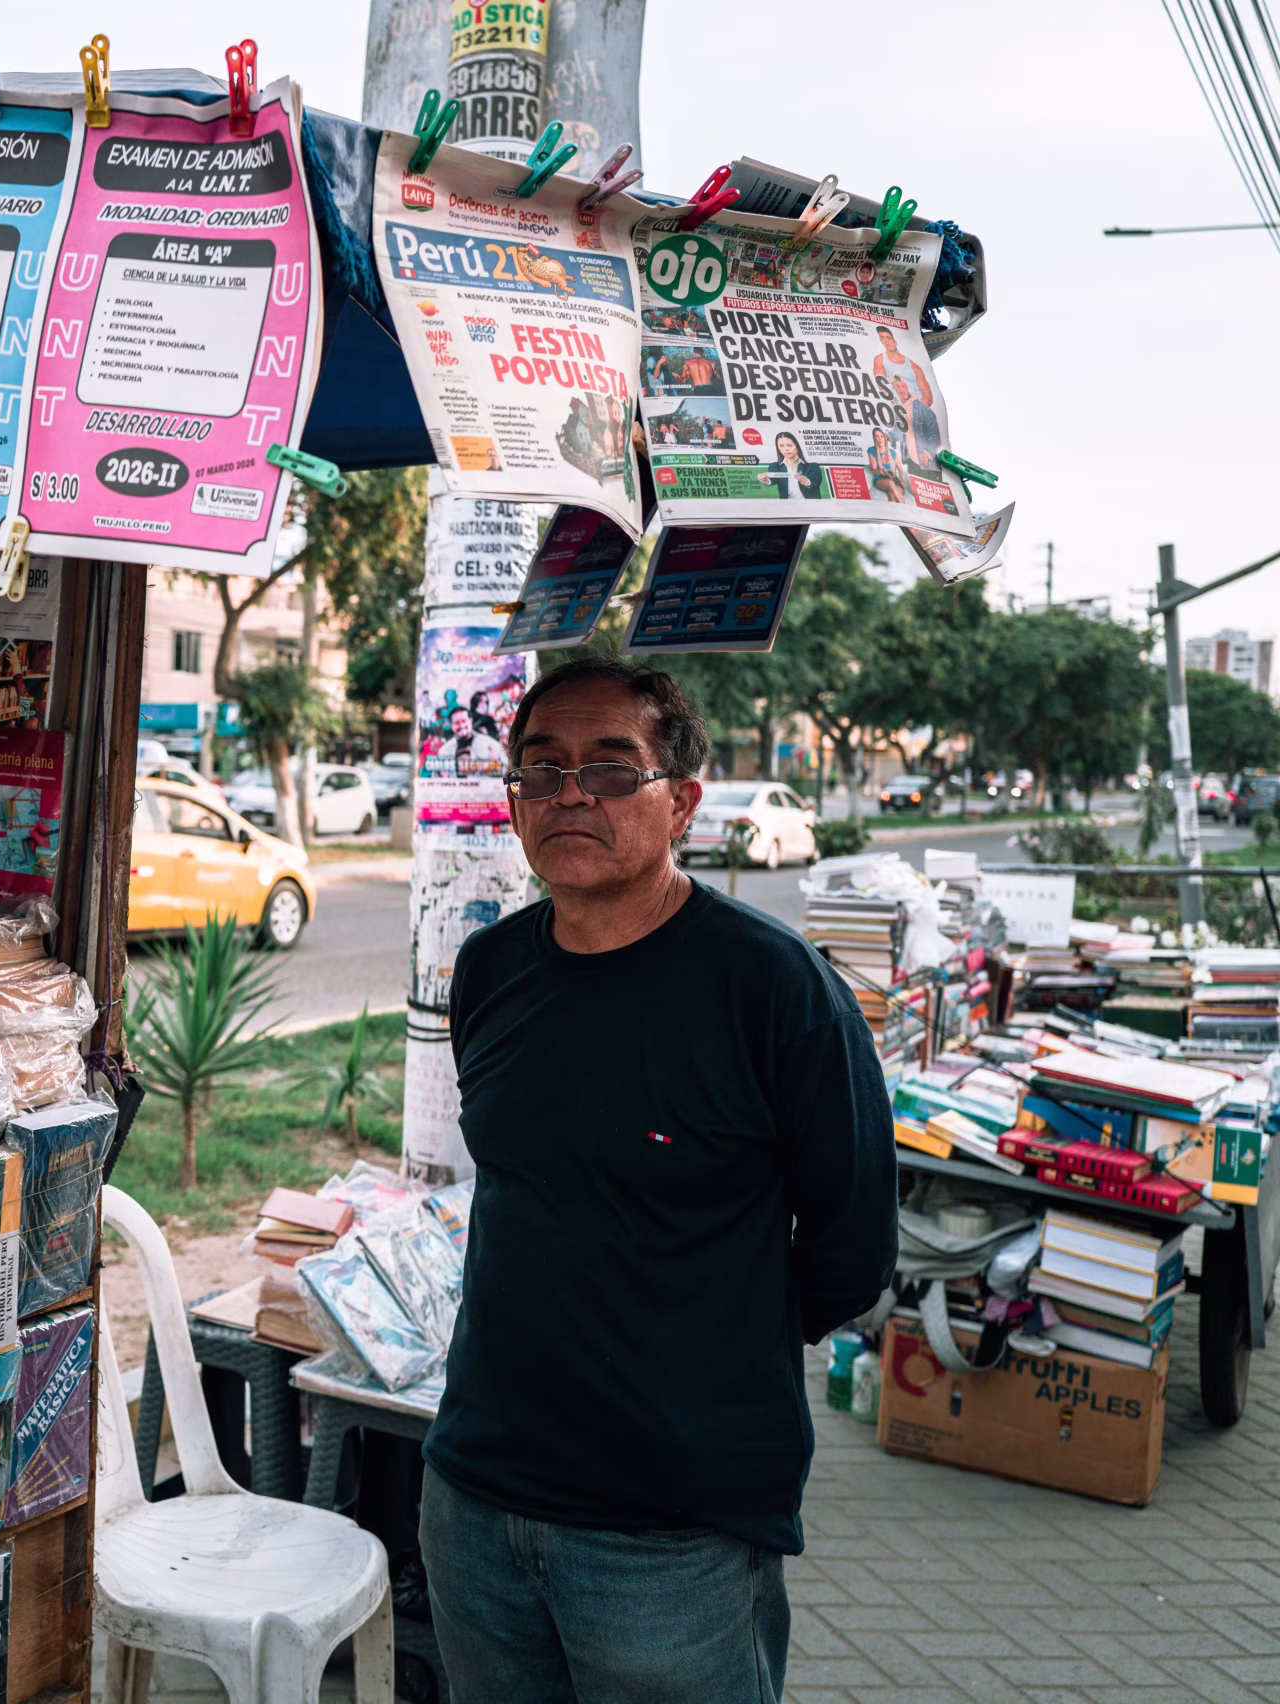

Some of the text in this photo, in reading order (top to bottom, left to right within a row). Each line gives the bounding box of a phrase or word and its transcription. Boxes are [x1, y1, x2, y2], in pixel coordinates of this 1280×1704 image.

[107, 138, 274, 171] EXAMEN DE ADMISIÓN
[165, 174, 252, 192] A LA U.N.T.
[404, 188, 433, 206] LAIVE
[99, 205, 289, 226] MODALIDAD: ORDINARIO
[449, 193, 549, 226] Defensas de acero
[152, 238, 199, 262] ÁREA
[392, 227, 489, 278] Perú
[123, 269, 246, 287] CIENCIA DE LA SALUD Y LA VIDA
[650, 241, 722, 300] ojo
[115, 297, 153, 308] BIOLOGÍA
[465, 293, 492, 303] MENOS
[494, 295, 504, 304] DE
[506, 296, 518, 305] UN
[520, 296, 535, 306] MES
[536, 299, 548, 309] DE
[550, 299, 562, 309] LAS
[563, 301, 604, 317] ELECCIONES,
[727, 298, 906, 328] FUTUROS ESPOSOS PARTICIPEN DE ESAS REUNIONES
[736, 289, 894, 317] USUARIAS DE TIKTOK NO PERMITIRÁN QUE SUS
[112, 310, 163, 322] ENFERMERÍA
[464, 315, 499, 328] PIENSO,
[709, 308, 794, 338] PIDEN
[109, 322, 176, 335] ESTOMATOLOGÍA
[467, 324, 496, 335] LUEGO
[469, 332, 495, 343] VOTO
[103, 348, 142, 357] MEDICINA
[106, 335, 146, 345] FARMACIA
[156, 340, 206, 351] BIOQUÍMICA
[510, 324, 606, 361] FESTÍN
[719, 336, 861, 369] CANCELAR
[98, 372, 142, 382] PESQUERÍA
[489, 353, 628, 399] POPULISTA
[727, 363, 893, 401] DESPEDIDAS
[733, 394, 907, 430] DE SOLTEROS
[86, 410, 212, 441] DESARROLLADO
[104, 458, 180, 488] 2026-II
[676, 467, 725, 478] PERUANOS
[680, 478, 728, 488] YA TIENEN
[31, 473, 46, 499] S/
[48, 475, 79, 501] 3.00
[661, 487, 729, 498] A SUS RIVALES
[94, 518, 170, 532] TRUJILLO-PERÚ
[455, 561, 489, 577] CEL:
[25, 753, 54, 770] plana
[0, 1239, 8, 1270] PERÚ
[0, 1272, 7, 1291] DEL
[16, 1335, 87, 1444] MATEMATICA
[1035, 1382, 1141, 1420] APPLES
[38, 1370, 80, 1435] BASICA
